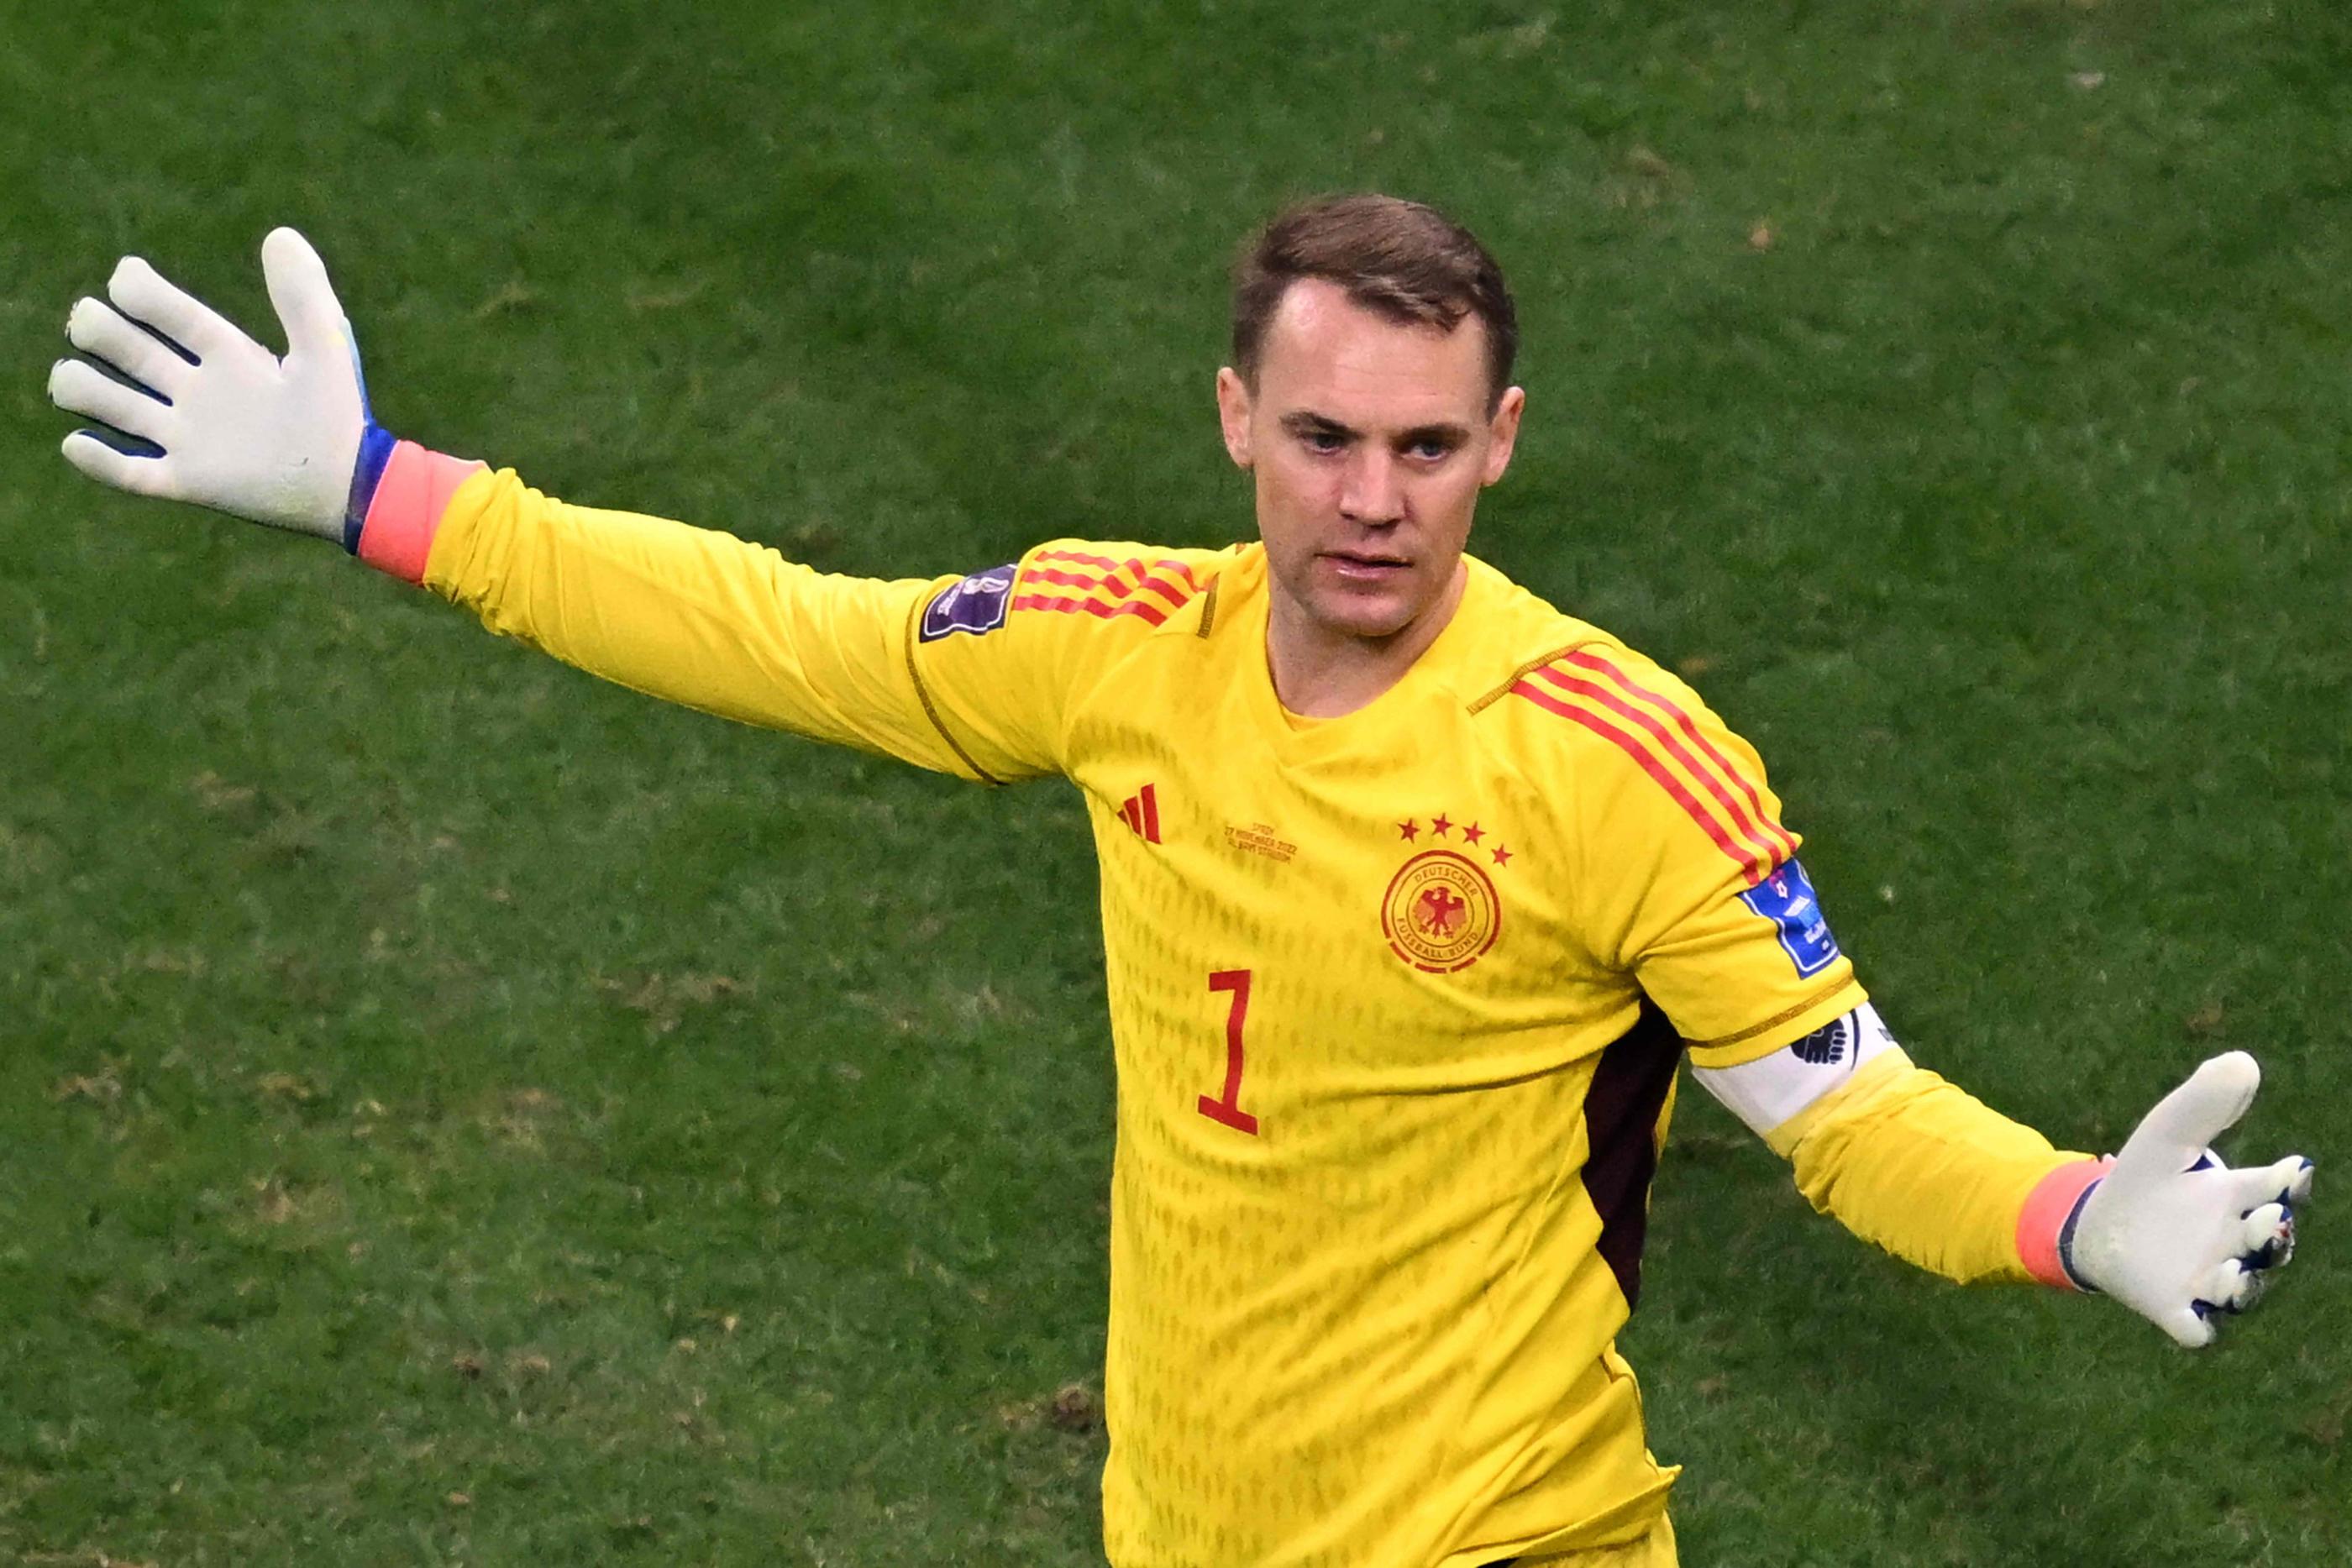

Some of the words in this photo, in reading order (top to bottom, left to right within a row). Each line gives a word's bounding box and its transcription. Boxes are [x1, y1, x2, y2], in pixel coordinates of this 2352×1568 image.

[1277, 841, 1298, 855] 2022
[1415, 867, 1478, 896] DEUTSCHER
[1198, 969, 1258, 1136] 1
